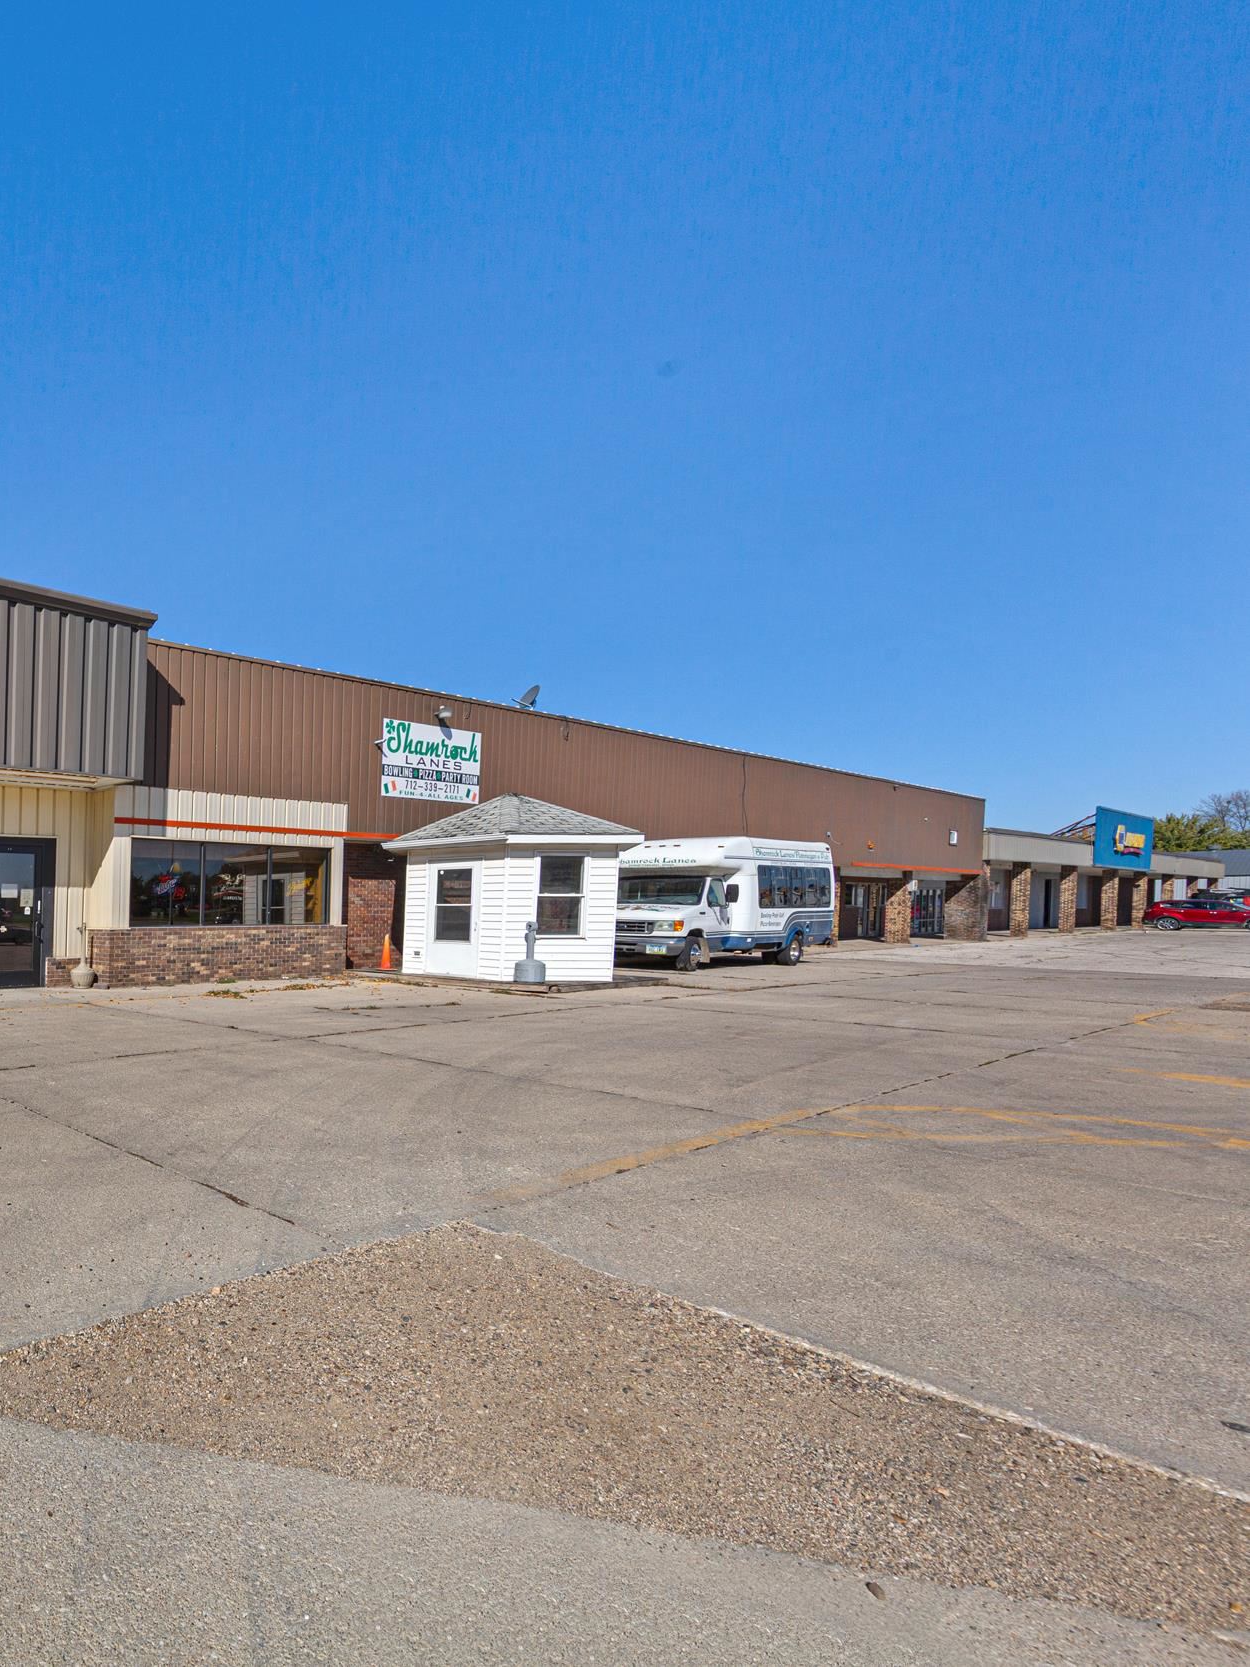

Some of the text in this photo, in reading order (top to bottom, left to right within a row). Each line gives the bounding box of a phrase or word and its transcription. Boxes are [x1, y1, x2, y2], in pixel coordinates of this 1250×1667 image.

[386, 722, 479, 763] Shamrock
[405, 755, 463, 771] LANES
[383, 765, 478, 785] BOWLING PIZZA PARTY ROOM
[405, 780, 460, 794] 712-339-2171
